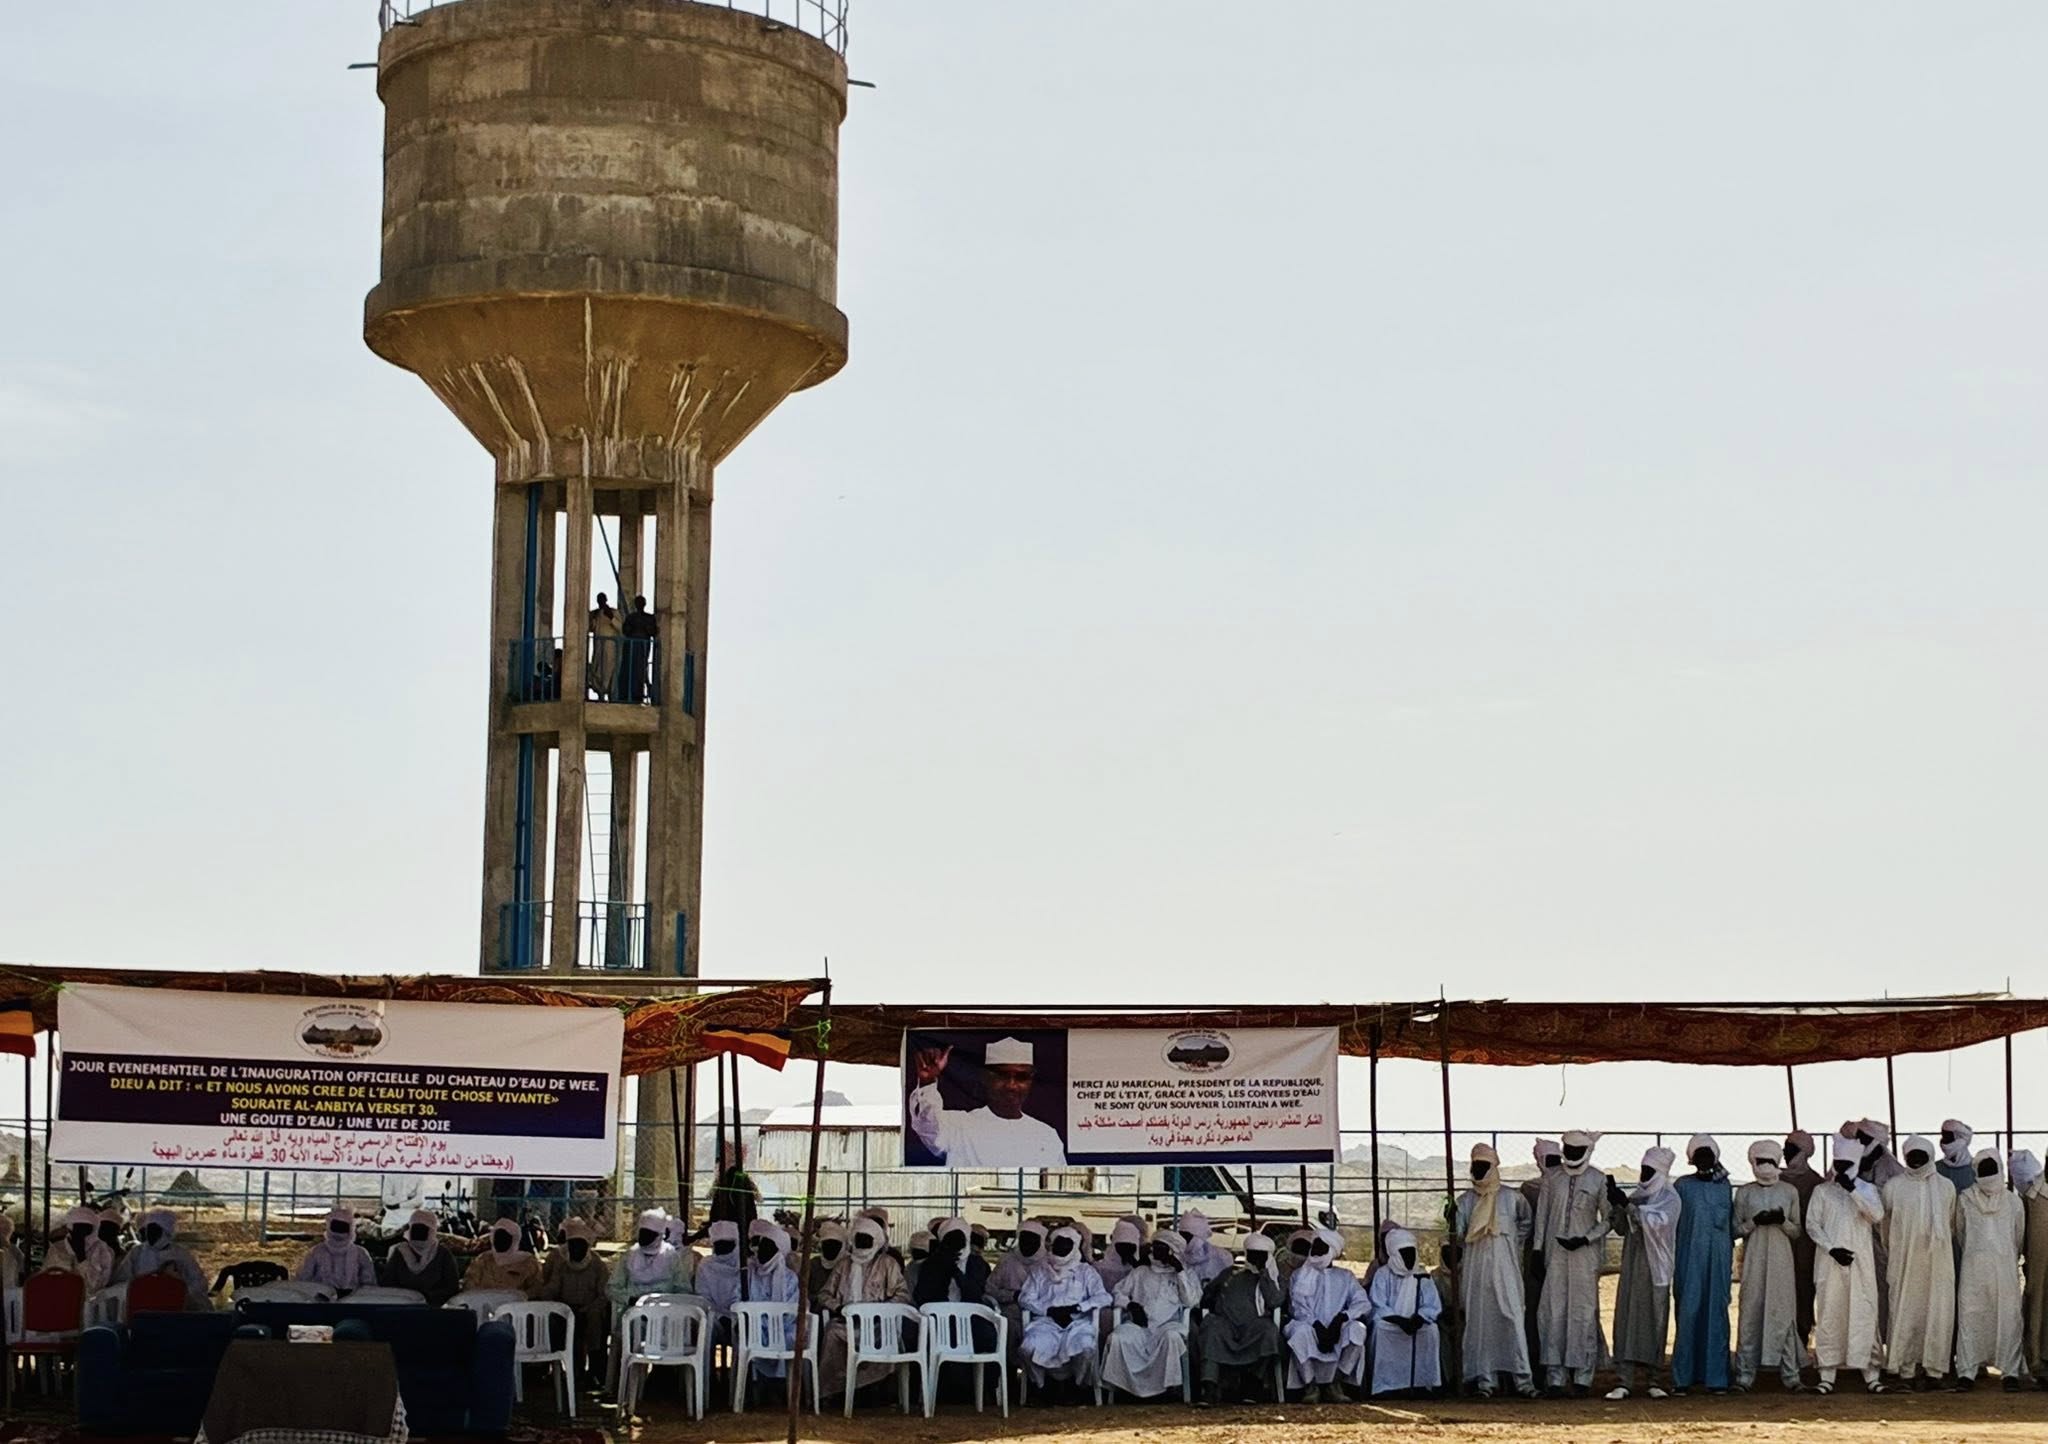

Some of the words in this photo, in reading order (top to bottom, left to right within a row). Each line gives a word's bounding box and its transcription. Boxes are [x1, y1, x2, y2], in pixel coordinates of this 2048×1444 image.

[69, 1060, 105, 1073] JOUR
[108, 1062, 207, 1076] EVENEMENTIEL
[211, 1066, 227, 1077] DE
[231, 1066, 343, 1081] L'INAUGURATION
[347, 1071, 419, 1084] OFFICIELLE
[426, 1074, 445, 1085] DU
[448, 1075, 506, 1088] CHATEAU
[509, 1077, 546, 1089] D'EAU
[550, 1079, 565, 1090] DE
[569, 1080, 599, 1091] WEE.
[110, 1078, 143, 1089] DIEU
[146, 1079, 156, 1089] A
[159, 1079, 183, 1091] DIT
[206, 1081, 222, 1093] ET
[226, 1082, 262, 1094] NOUS
[265, 1084, 309, 1095] AVONS
[312, 1085, 345, 1097] CREE
[349, 1086, 365, 1098] DE
[368, 1088, 404, 1099] L'EAU
[408, 1089, 448, 1100] TOUTE
[452, 1090, 493, 1103] CHOSE
[1073, 1080, 1103, 1089] MERCI
[1122, 1080, 1175, 1089] MARECHAL,
[1178, 1079, 1231, 1088] PRESIDENT
[1233, 1079, 1246, 1087] DE
[1248, 1079, 1260, 1087] LA
[1262, 1078, 1324, 1088] REPUBLIQUE,
[1077, 1091, 1101, 1099] CHEF
[1104, 1091, 1116, 1099] DE
[1155, 1090, 1186, 1099] GRACE
[1188, 1090, 1195, 1098] A
[1198, 1090, 1226, 1099] VOUS,
[1228, 1090, 1245, 1098] LES
[1247, 1089, 1291, 1098] CORVEES
[1293, 1088, 1320, 1097] D'EAU
[232, 1097, 291, 1111] SOURATE
[294, 1099, 364, 1113] AL-ANBIYA
[368, 1102, 416, 1114] VERSET
[418, 1104, 437, 1115] 30.
[1094, 1102, 1107, 1110] NE
[1110, 1101, 1136, 1110] SONT
[1138, 1101, 1168, 1111] QU'UN
[1170, 1101, 1219, 1109] SOUVENIR
[1222, 1100, 1269, 1109] LOINTAIN
[1271, 1100, 1278, 1108] A
[1280, 1100, 1303, 1108] WEE.
[220, 1113, 247, 1125] UNE
[250, 1114, 294, 1126] GOUTE
[297, 1115, 335, 1127] D'EAU
[347, 1117, 372, 1128] UNE
[376, 1118, 398, 1129] VIE
[402, 1119, 418, 1130] DE
[421, 1120, 451, 1131] JOIE
[251, 1129, 263, 1142] الله
[266, 1127, 280, 1144] قال
[307, 1131, 331, 1146] المياه
[430, 1139, 447, 1151] يوم
[222, 1147, 237, 1159] ماء
[241, 1146, 264, 1162] قطرة
[347, 1151, 373, 1167] سورة
[400, 1152, 422, 1168] شيء
[425, 1153, 437, 1167] كل
[440, 1153, 461, 1165] الماء
[464, 1156, 478, 1169] من
